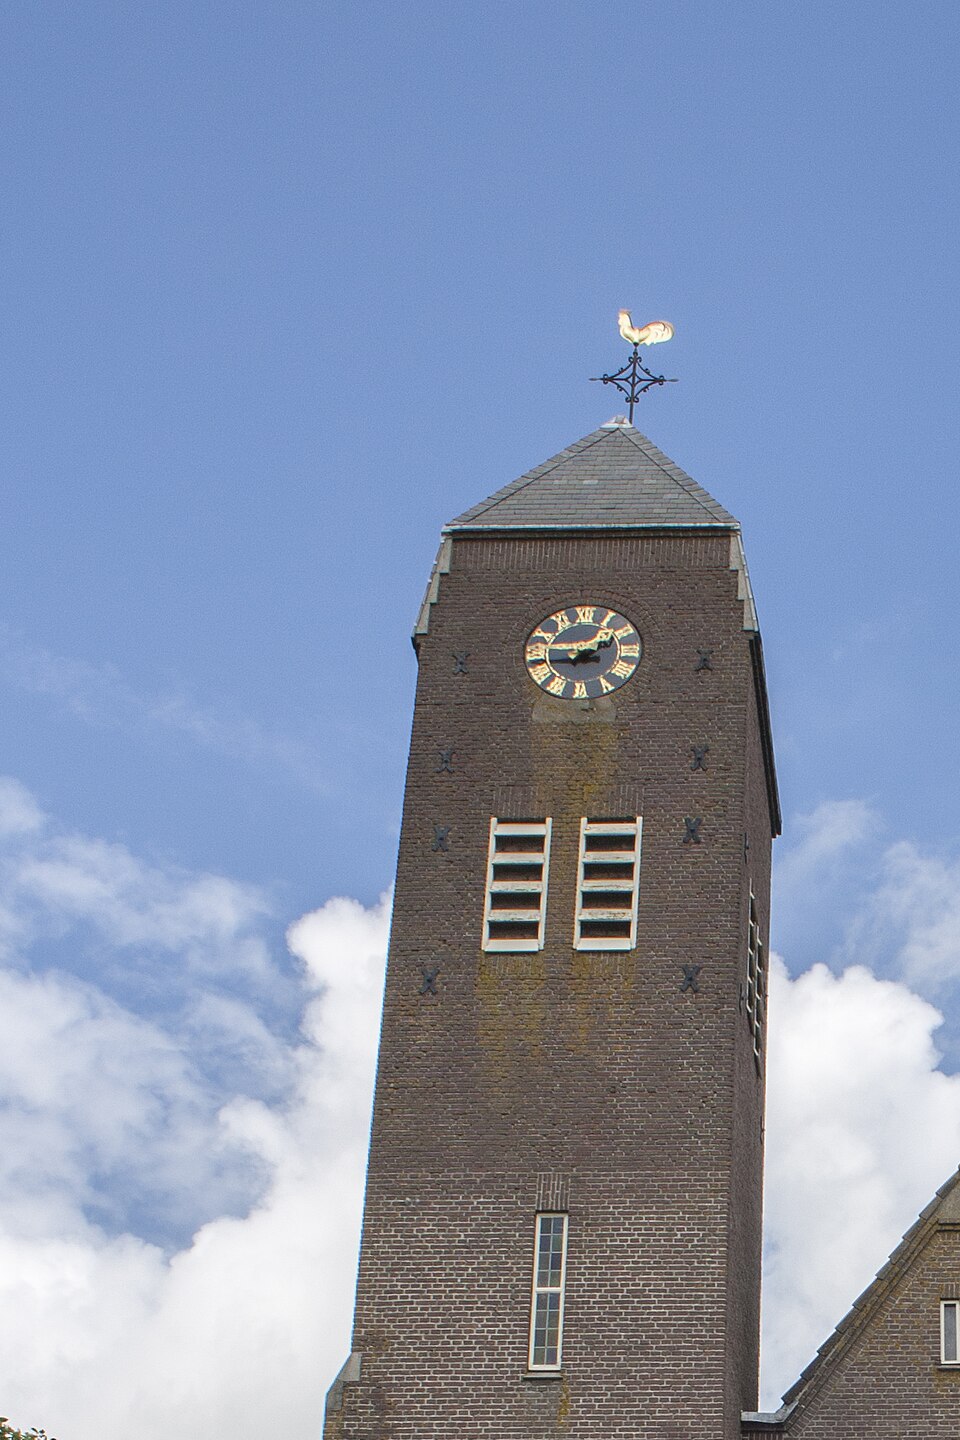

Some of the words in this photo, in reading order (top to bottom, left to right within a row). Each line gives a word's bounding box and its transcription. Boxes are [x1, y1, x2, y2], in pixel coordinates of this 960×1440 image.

[576, 607, 596, 622] XII
[601, 611, 616, 627] I
[533, 628, 554, 643] X
[620, 643, 640, 658] III
[573, 681, 588, 698] VI
[599, 675, 615, 693] V
